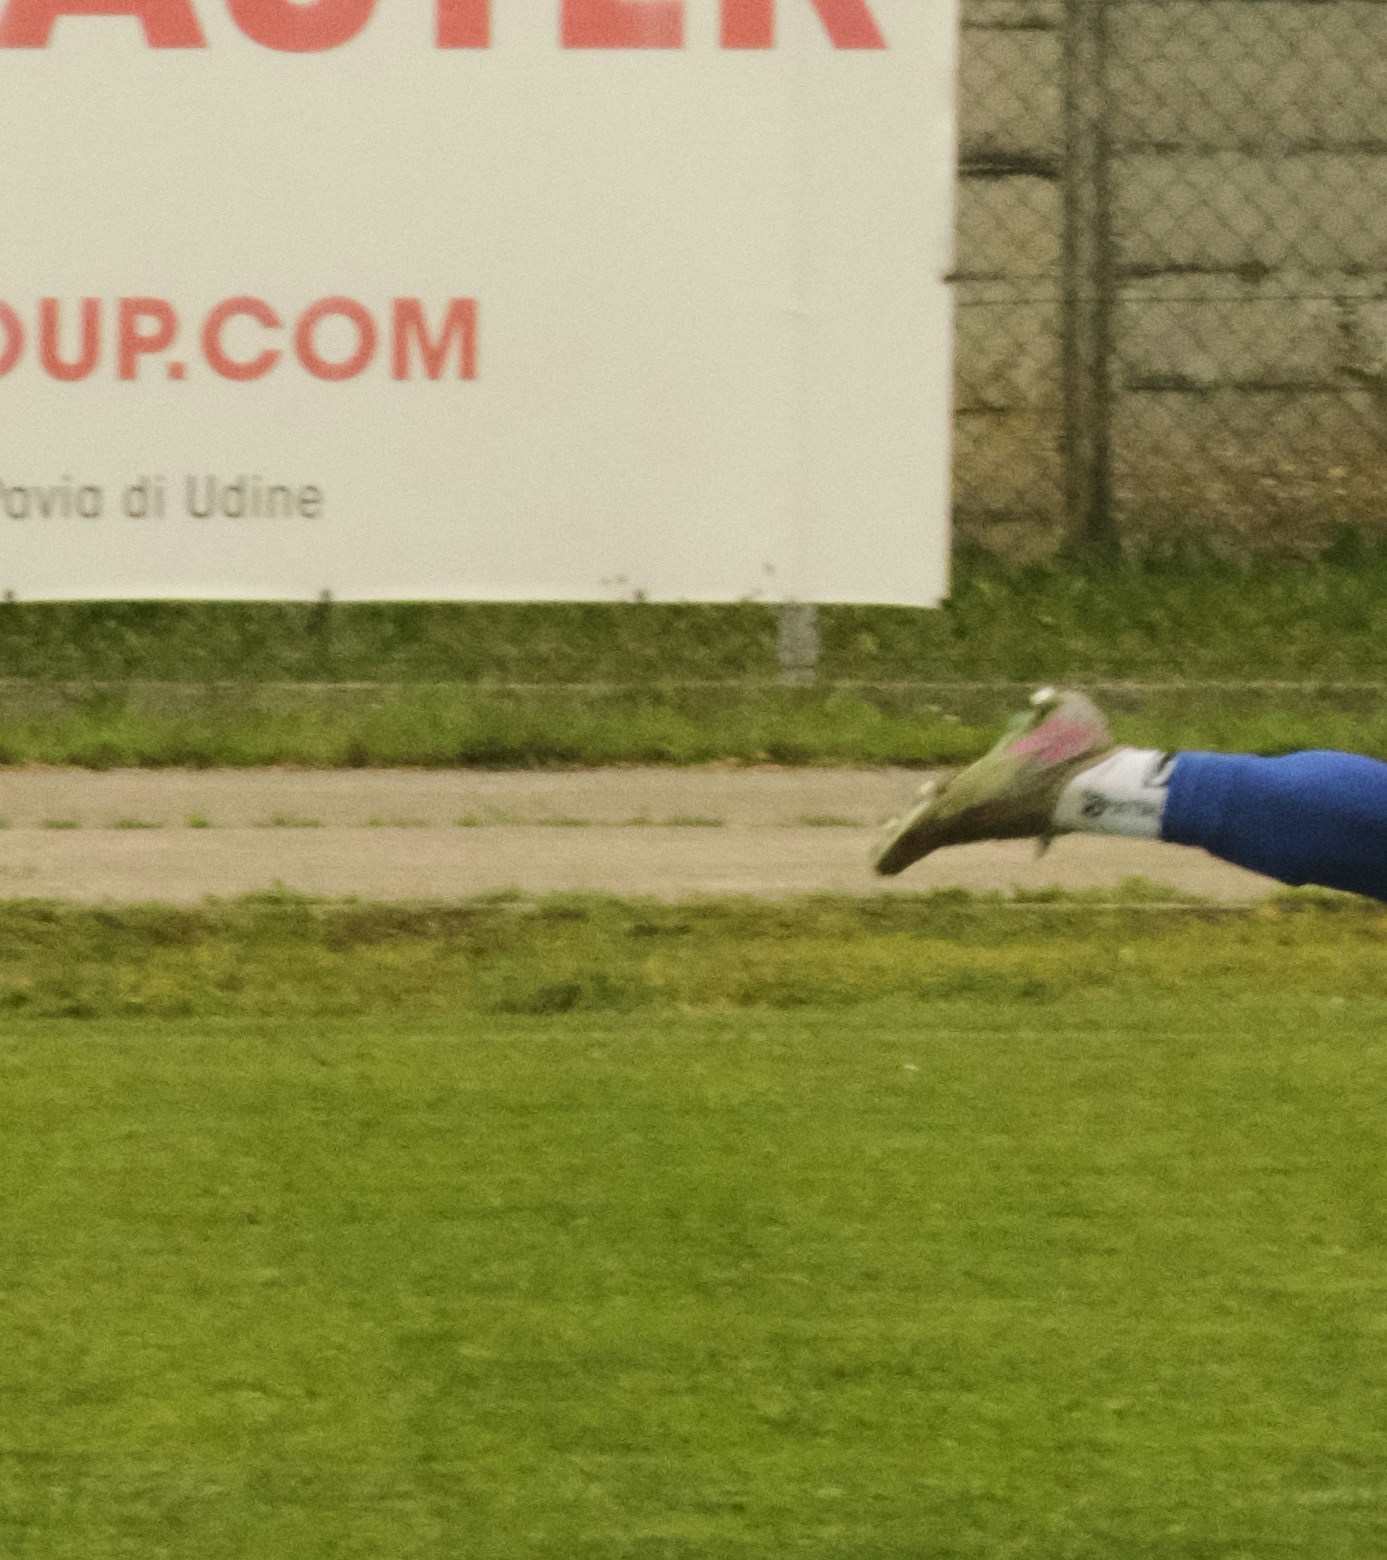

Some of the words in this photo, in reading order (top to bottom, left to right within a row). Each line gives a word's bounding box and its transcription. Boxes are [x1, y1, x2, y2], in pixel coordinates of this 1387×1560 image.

[0, 474, 104, 520] avia
[121, 473, 167, 520] di
[184, 473, 324, 520] Udine
